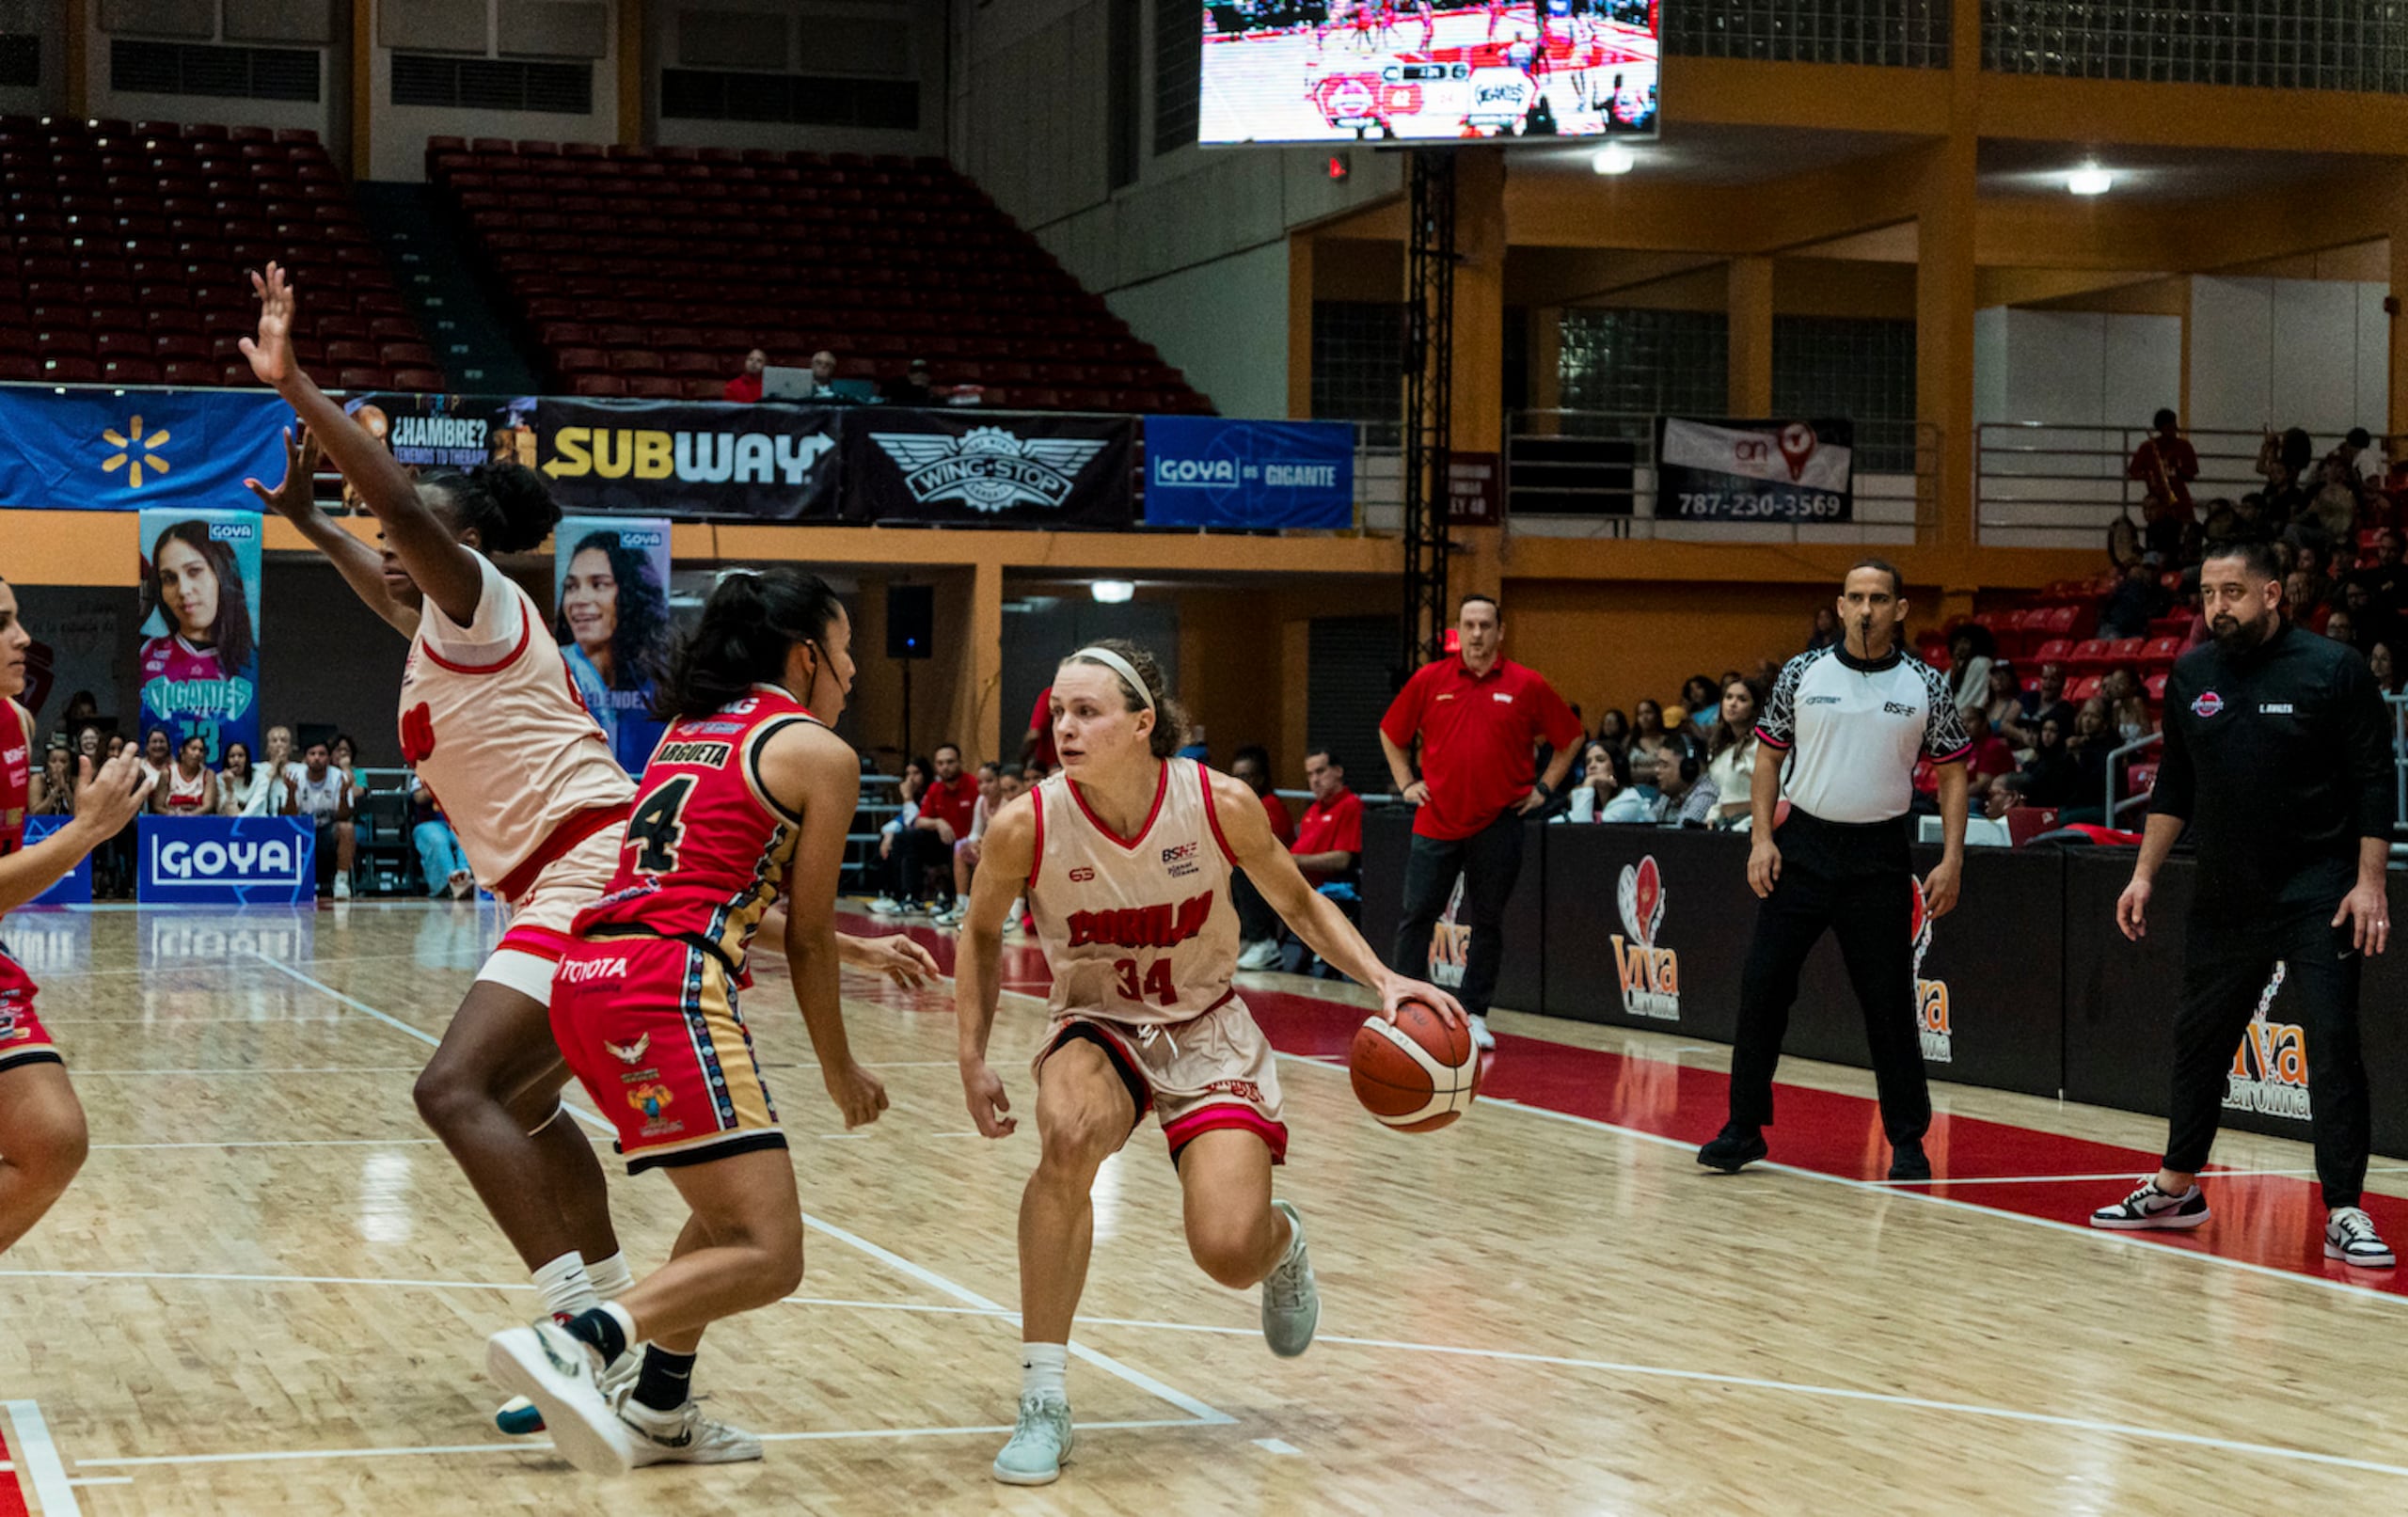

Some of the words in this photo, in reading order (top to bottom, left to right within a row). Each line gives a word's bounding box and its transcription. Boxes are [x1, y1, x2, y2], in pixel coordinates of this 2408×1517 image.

[391, 417, 488, 448] ¿HAMBRE?
[541, 426, 835, 484] SUBWAY
[1160, 459, 1234, 482] GOYA
[1264, 465, 1337, 487] GIGANTE
[1678, 493, 1841, 516] 787-230-3569
[211, 524, 253, 539] GOYA
[622, 532, 661, 545] GOYA
[625, 773, 700, 877] 4
[159, 839, 292, 878] GOYA
[561, 957, 627, 984] TOYOTA
[1610, 934, 1680, 998] Viva
[1114, 957, 1179, 1007] 34
